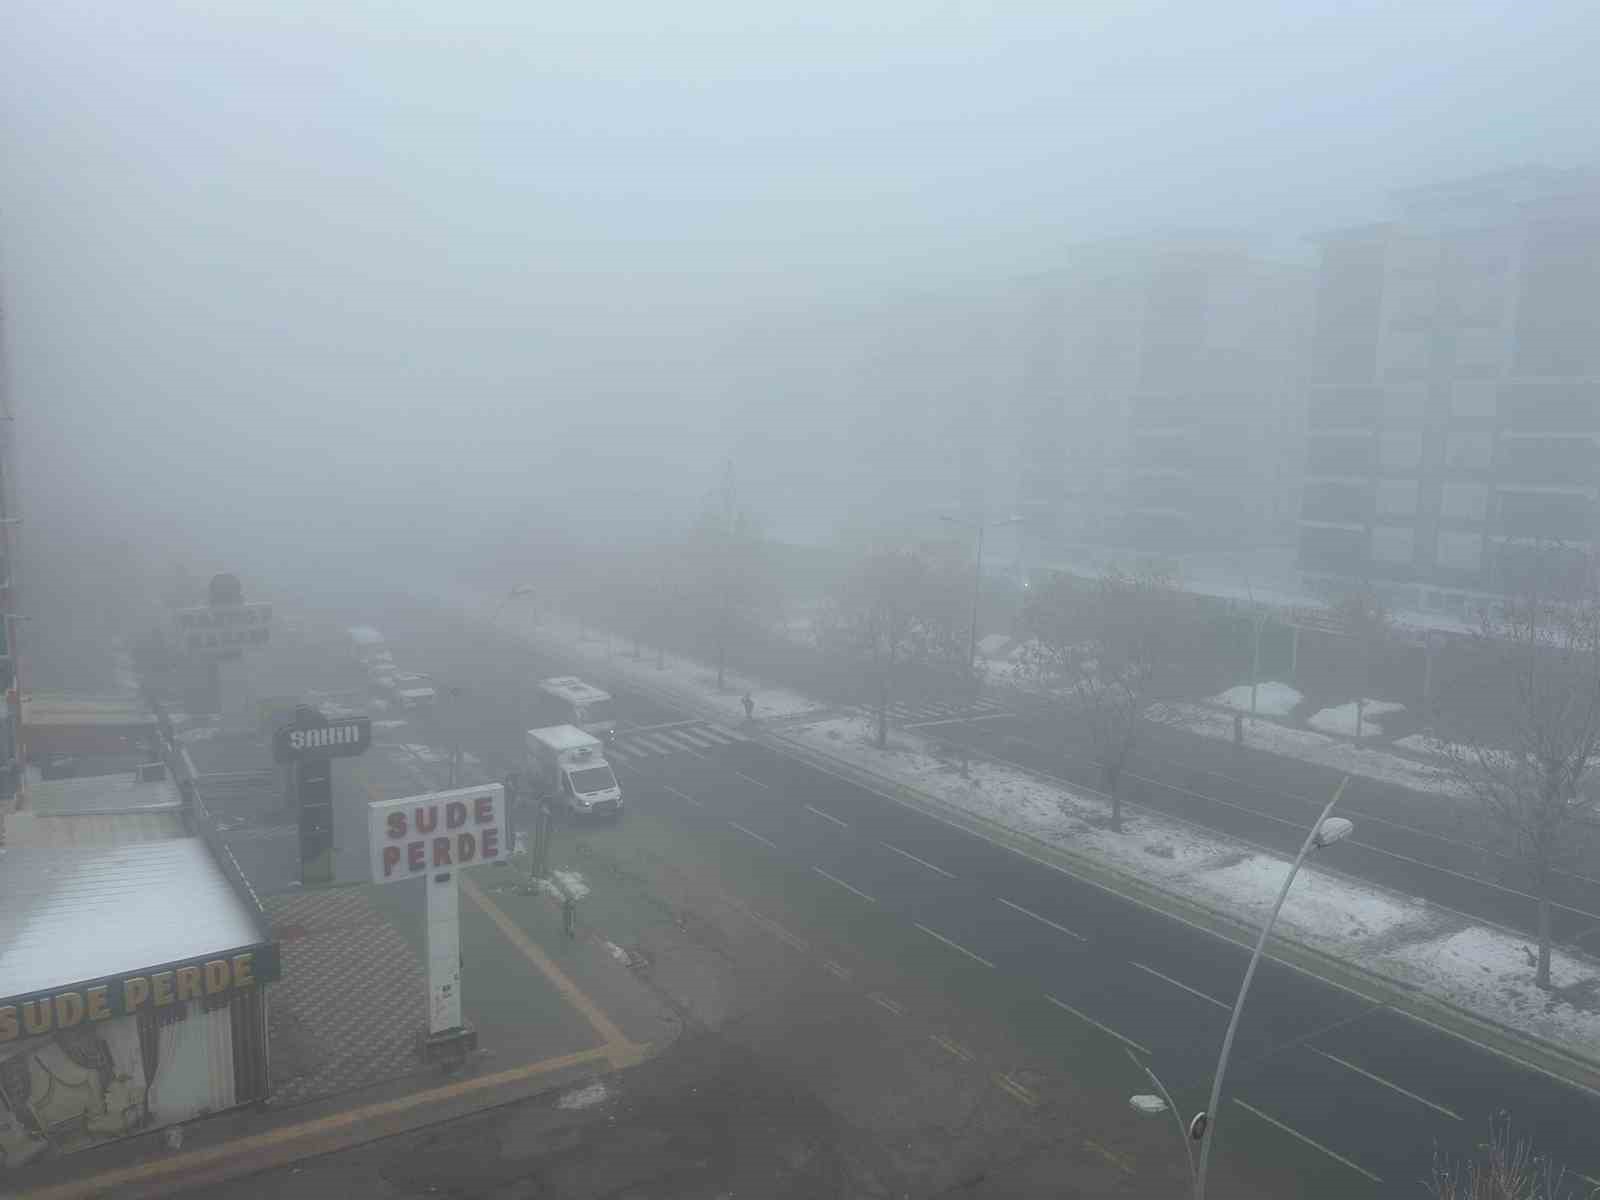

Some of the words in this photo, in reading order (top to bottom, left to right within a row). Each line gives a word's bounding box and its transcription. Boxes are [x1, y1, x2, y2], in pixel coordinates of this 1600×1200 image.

[387, 797, 494, 839] SUDE
[383, 828, 498, 877] PERDE
[0, 985, 113, 1042] SUDE
[124, 953, 256, 1012] PERDE
